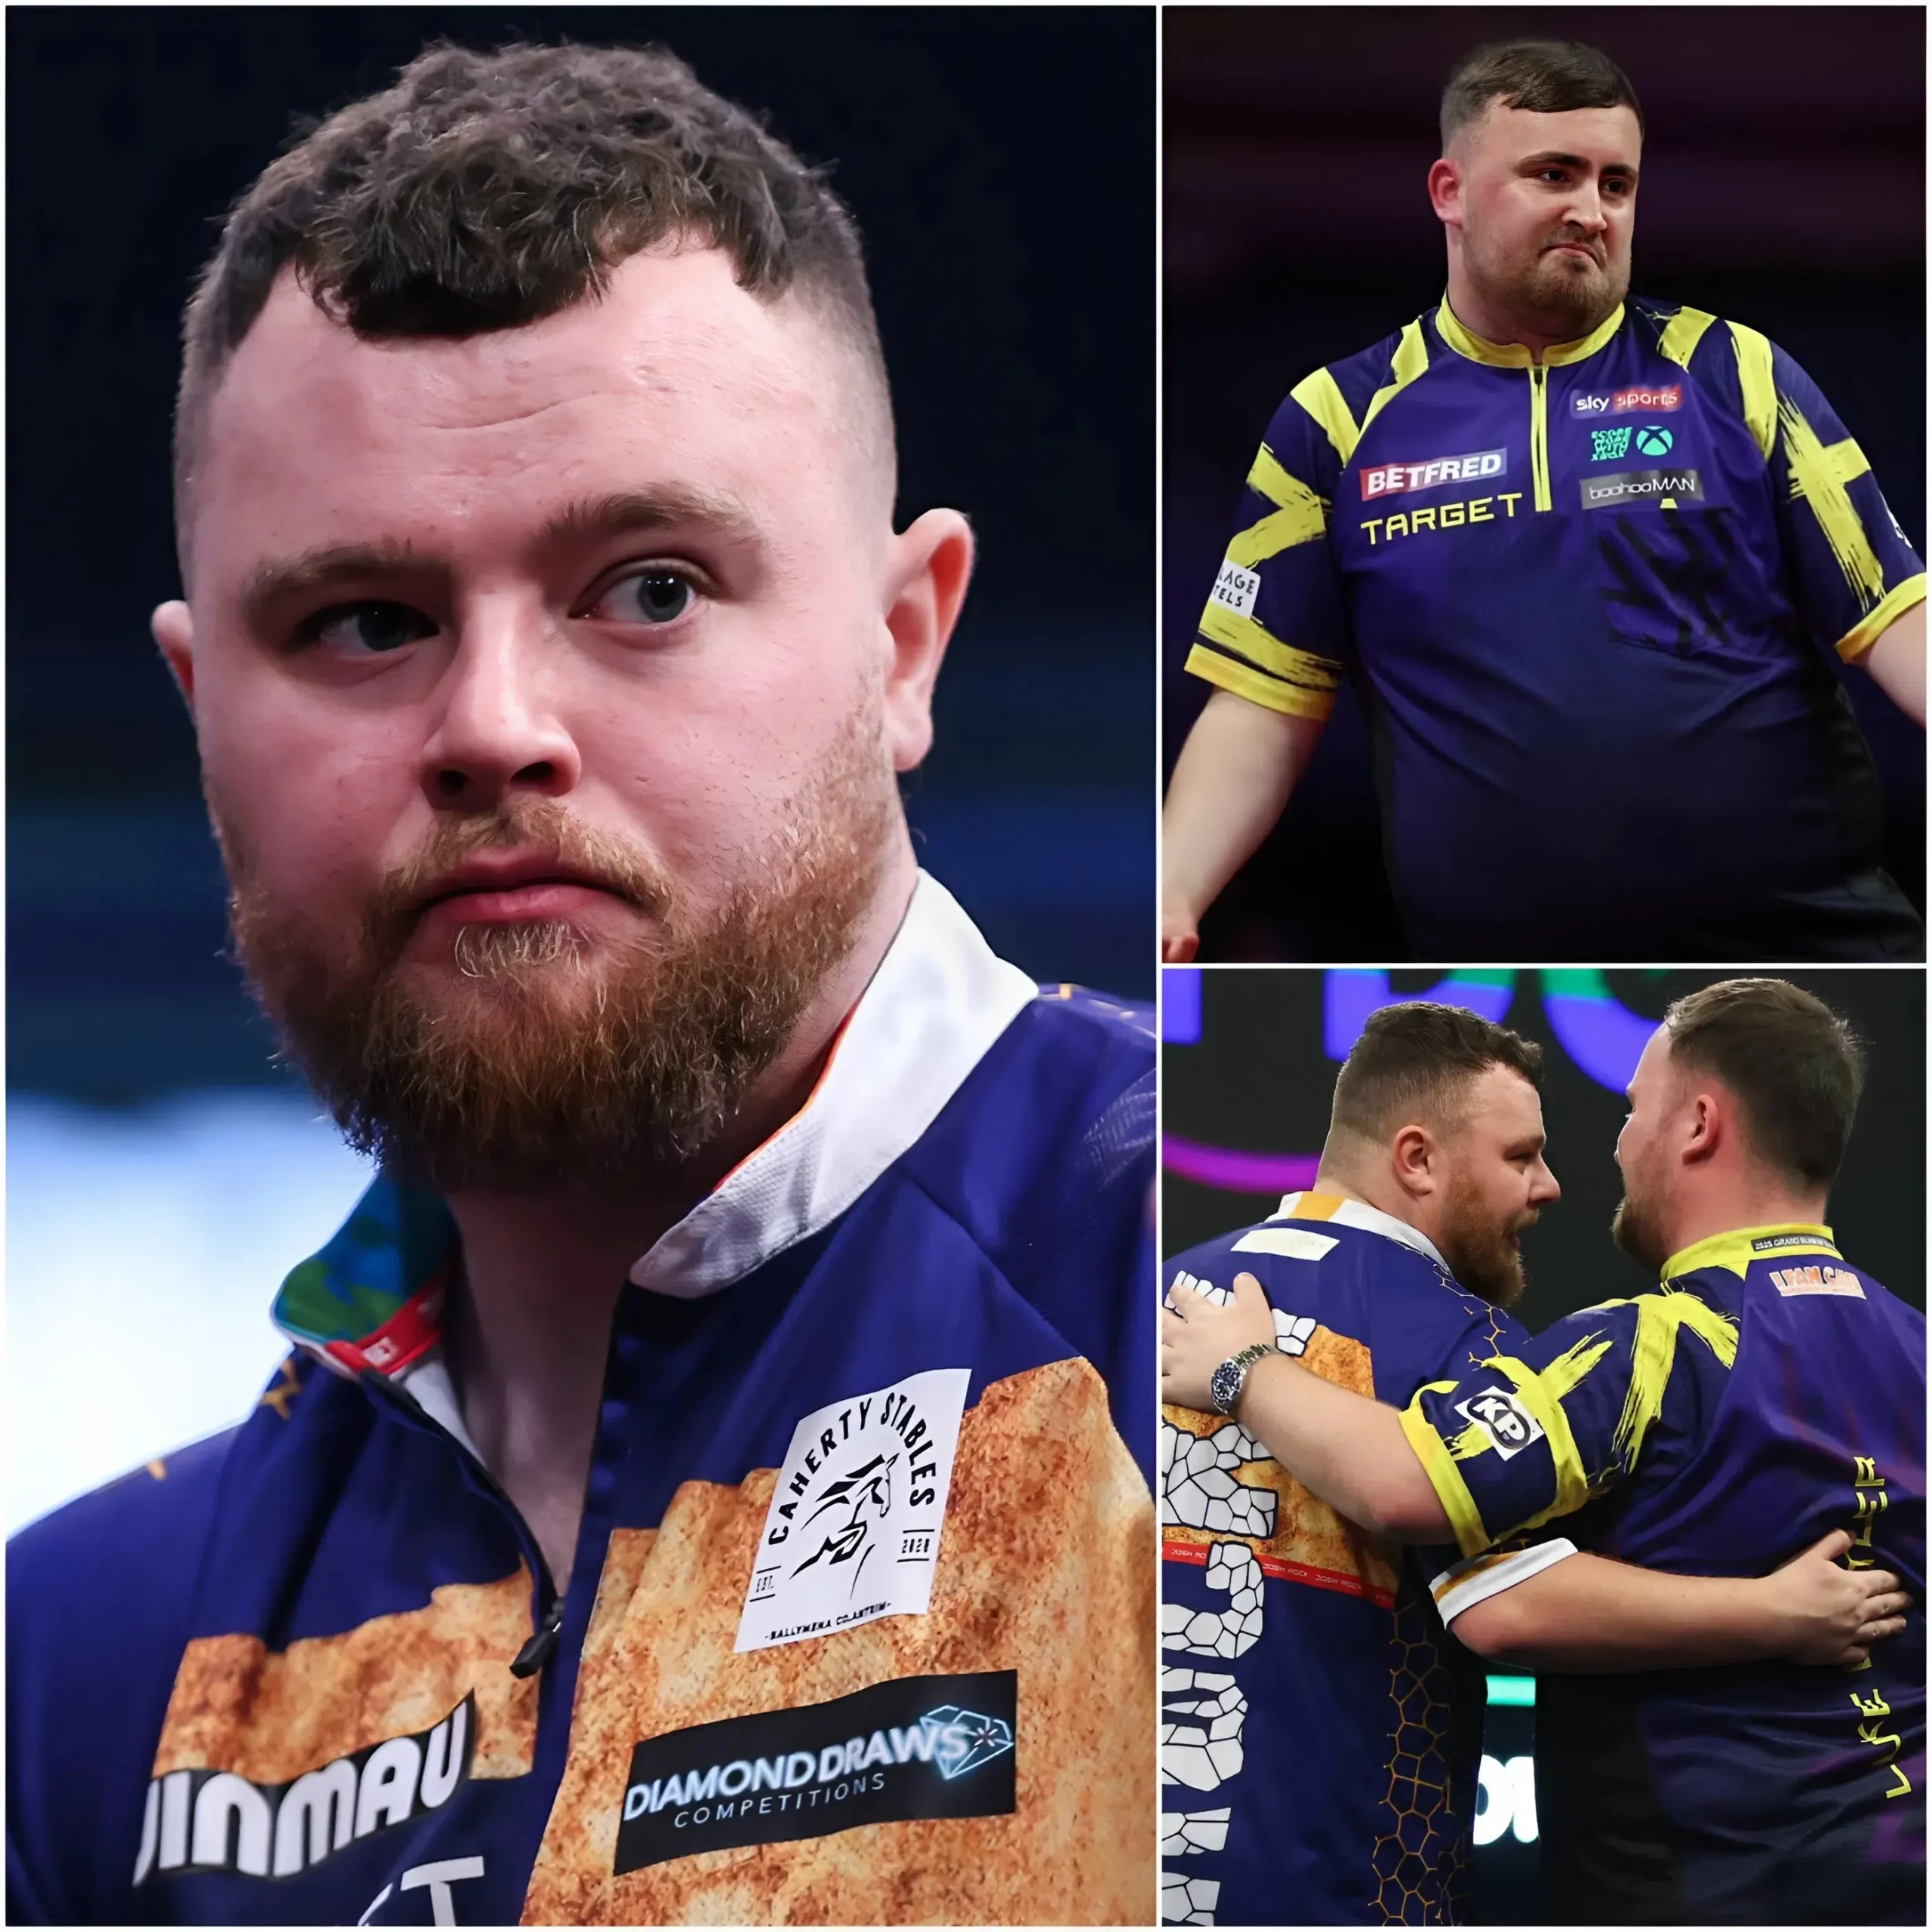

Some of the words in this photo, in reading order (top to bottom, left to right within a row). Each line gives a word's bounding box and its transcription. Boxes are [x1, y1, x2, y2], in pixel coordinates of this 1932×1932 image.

[1576, 395, 1610, 412] sky
[1367, 454, 1502, 496] BETFRED
[1589, 477, 1695, 500] boohooMAN
[1360, 492, 1523, 545] TARGET
[1470, 1395, 1527, 1443] KP
[768, 1397, 872, 1546] CAHERTY
[880, 1392, 937, 1507] STABLES
[673, 1771, 886, 1829] COMPETITIONS
